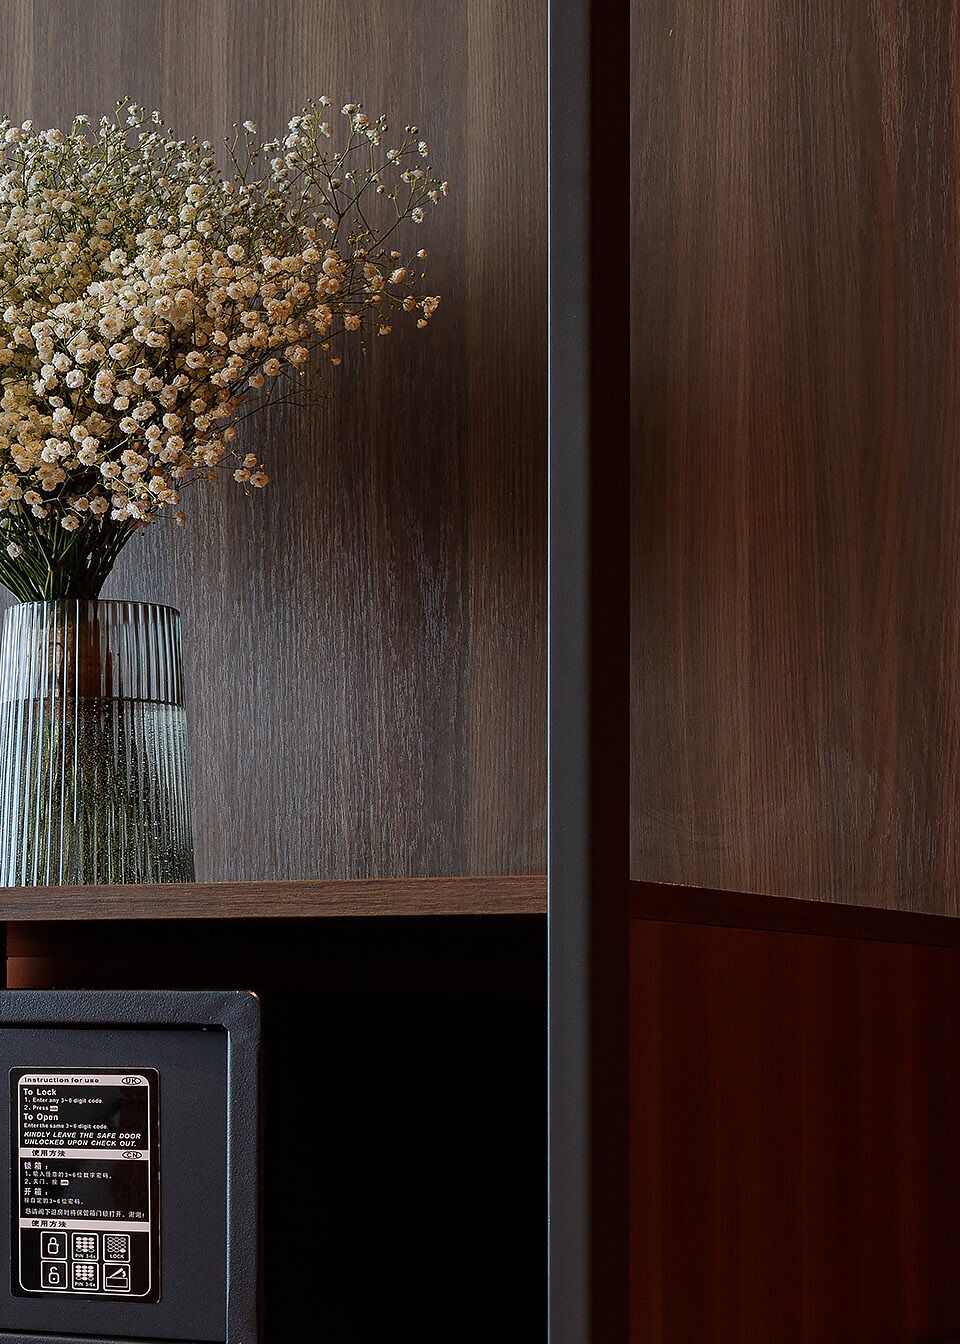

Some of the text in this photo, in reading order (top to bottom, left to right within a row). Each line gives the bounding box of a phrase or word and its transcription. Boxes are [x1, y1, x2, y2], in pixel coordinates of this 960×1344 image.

[24, 1076, 69, 1084] Instruction
[71, 1076, 82, 1084] for
[23, 1088, 57, 1096] To Lock
[36, 1113, 59, 1122] Open
[32, 1149, 66, 1157] 使用方法
